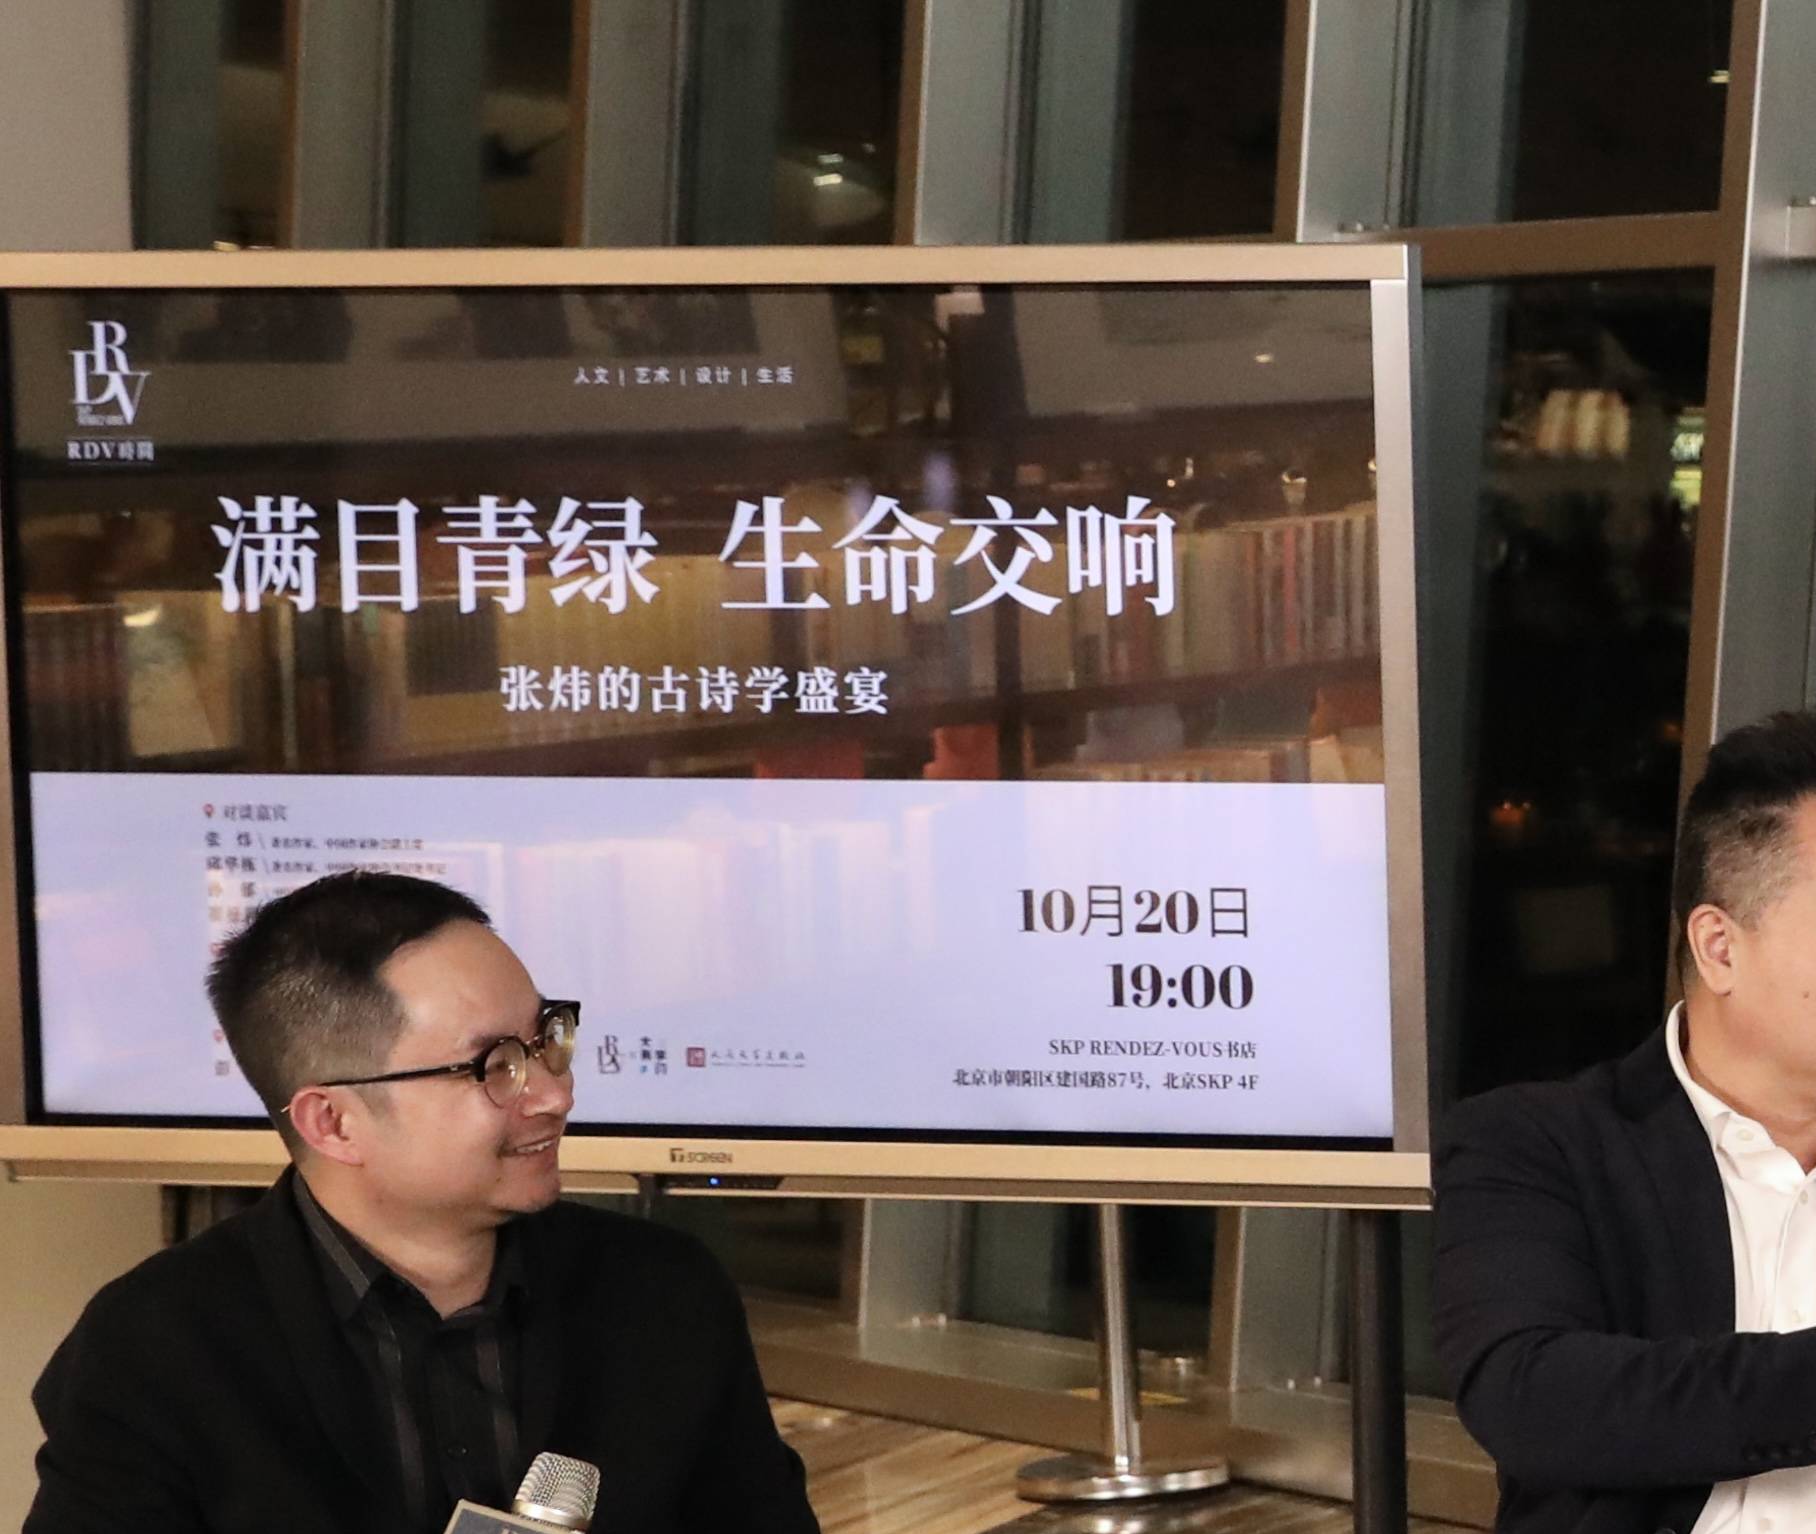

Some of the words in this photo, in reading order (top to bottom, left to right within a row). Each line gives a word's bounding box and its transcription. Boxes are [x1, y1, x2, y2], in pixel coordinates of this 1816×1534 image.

[68, 320, 151, 425] RDV
[574, 366, 609, 384] 人文
[635, 366, 670, 384] 艺术
[696, 366, 731, 384] 设计
[756, 366, 793, 384] 生活
[212, 496, 659, 615] 满目青绿
[720, 496, 1176, 617] 生命交响
[499, 664, 889, 716] 张炜的古诗学盛宴
[1017, 885, 1249, 938] 10月20日
[1105, 963, 1254, 1009] 19:00
[1048, 1040, 1085, 1056] SKP
[1237, 1074, 1259, 1090] 4F
